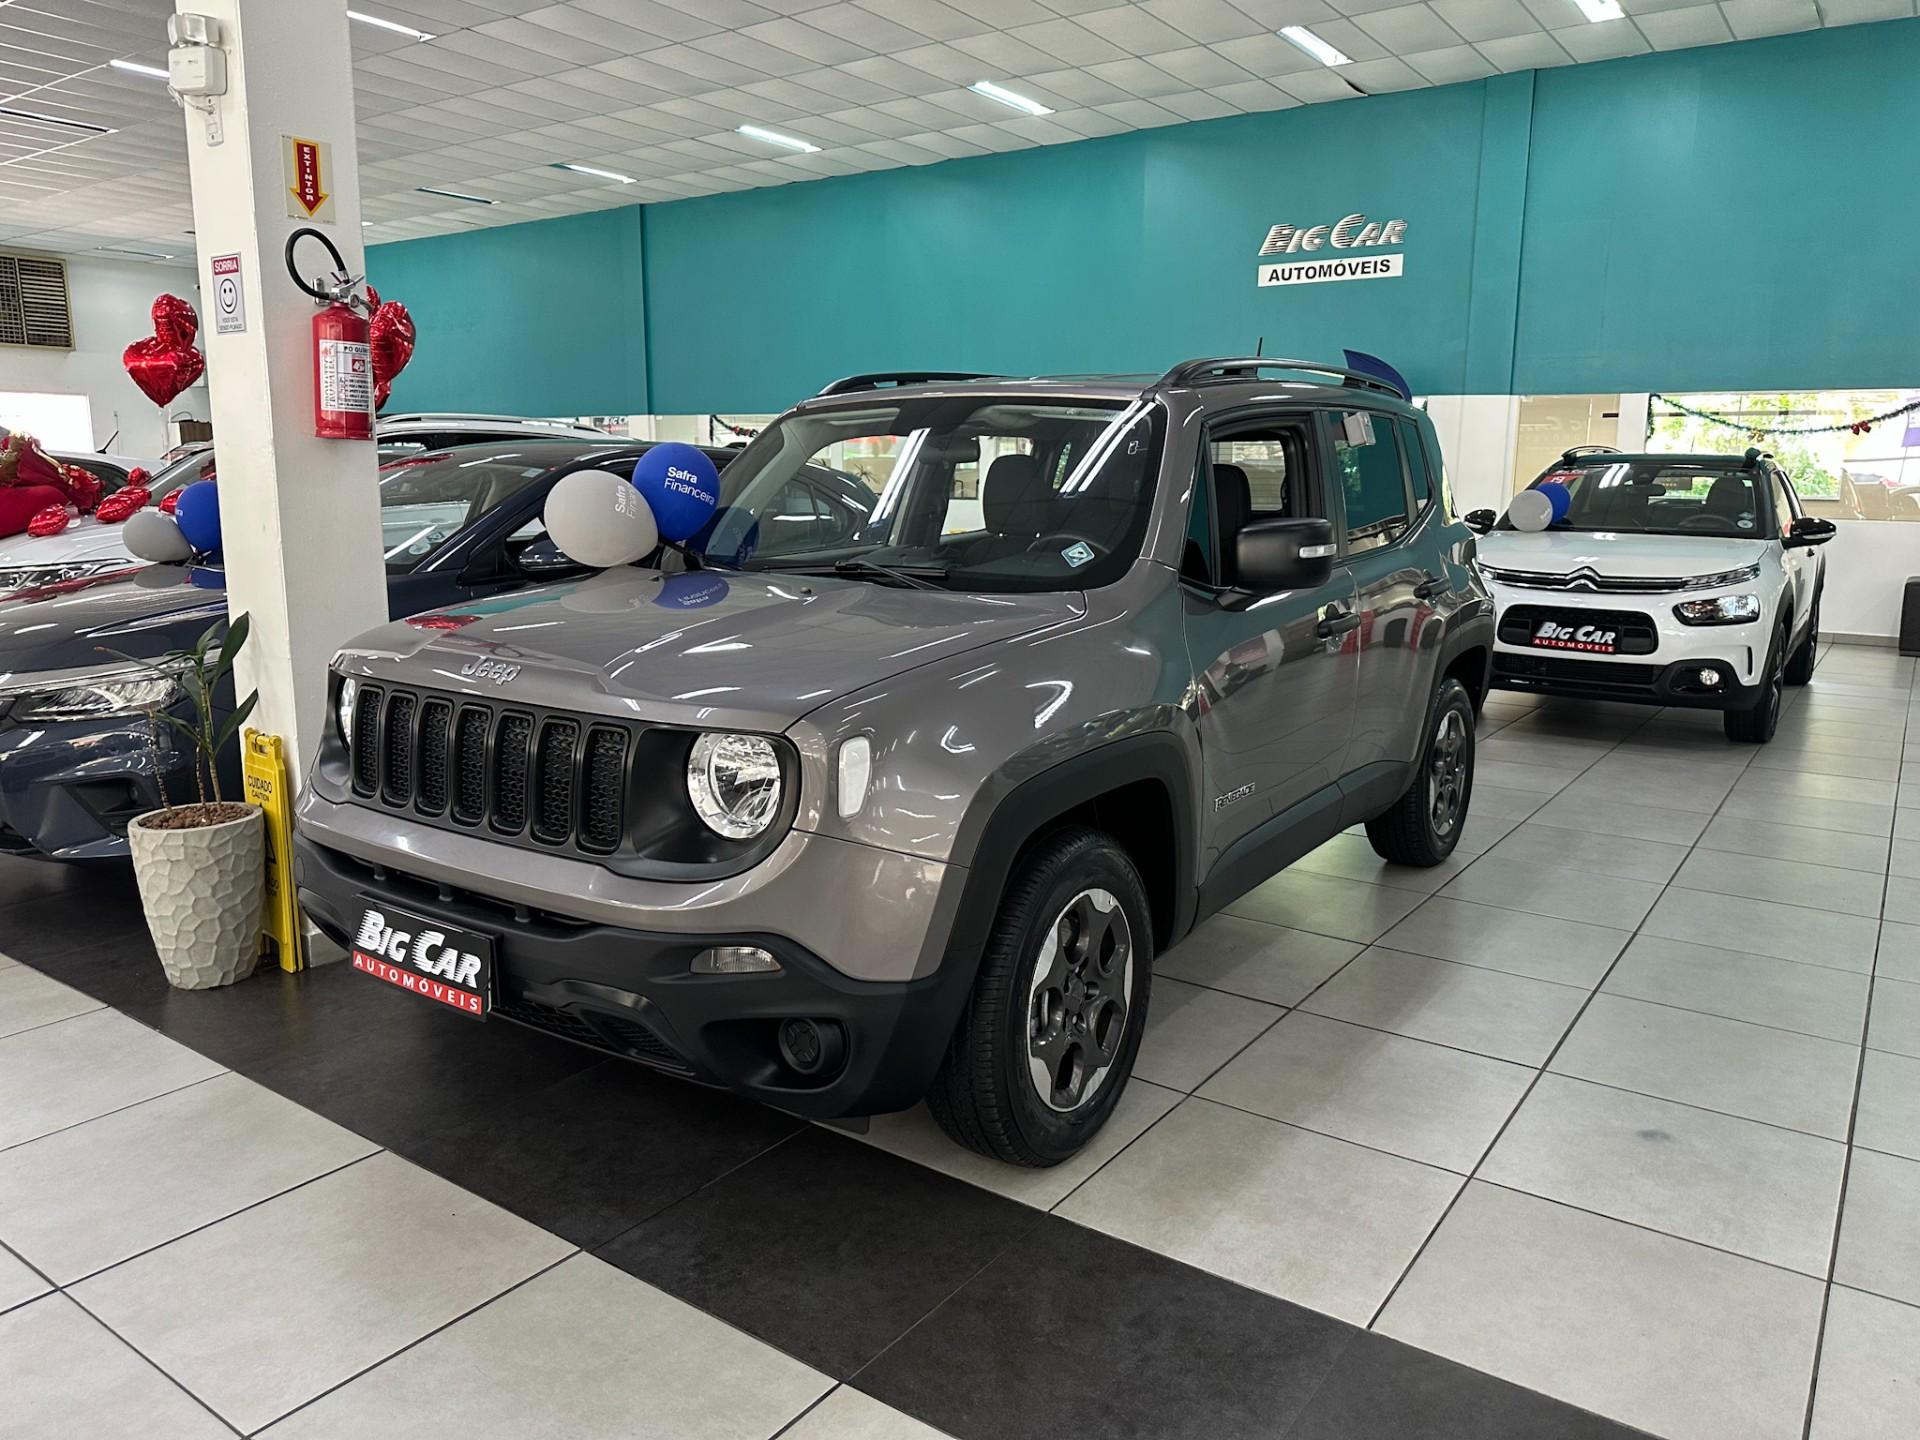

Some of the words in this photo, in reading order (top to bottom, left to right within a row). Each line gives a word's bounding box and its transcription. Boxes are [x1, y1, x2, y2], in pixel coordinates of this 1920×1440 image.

[303, 146, 314, 201] EXTINTOR
[1330, 213, 1408, 249] CAR
[214, 258, 238, 273] SORRIA
[1268, 258, 1391, 283] AUTOMÓVEIS
[667, 466, 698, 484] Safra
[614, 485, 626, 513] Safra
[664, 477, 715, 506] Financeira
[1536, 622, 1575, 640] BIG
[1575, 625, 1616, 644] CAR
[461, 655, 521, 686] Jeep
[247, 774, 273, 794] CUIDADO
[251, 789, 270, 802] CAUTION
[354, 909, 412, 963] BIG
[411, 929, 482, 989] CAR
[354, 953, 479, 1012] AUTOMÓVEIS
